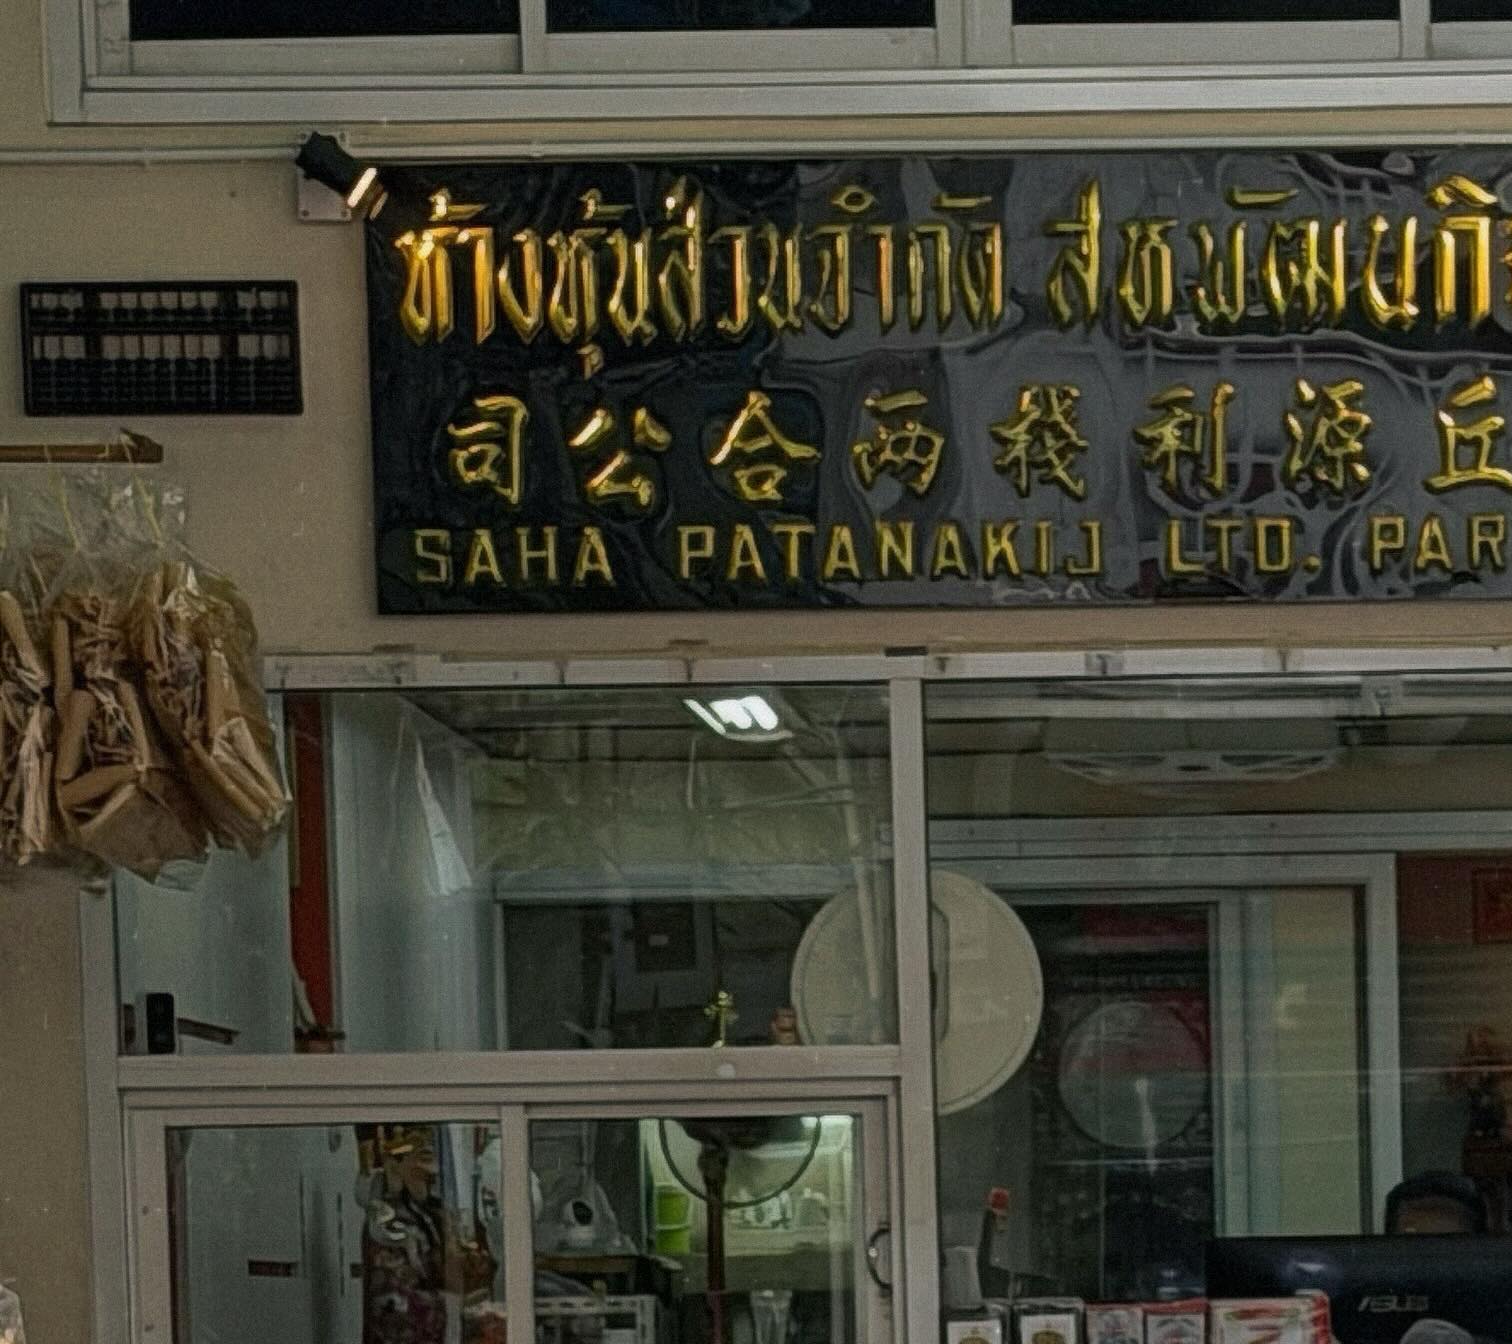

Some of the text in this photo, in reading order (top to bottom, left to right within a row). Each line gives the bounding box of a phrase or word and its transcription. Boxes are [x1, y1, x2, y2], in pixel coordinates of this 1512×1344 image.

[393, 176, 1003, 380] ห้างหุ้นส่วนจำกัด
[414, 523, 615, 589] SAHA
[677, 518, 1102, 584] PATANAKIJ
[1165, 517, 1322, 578] LTD.
